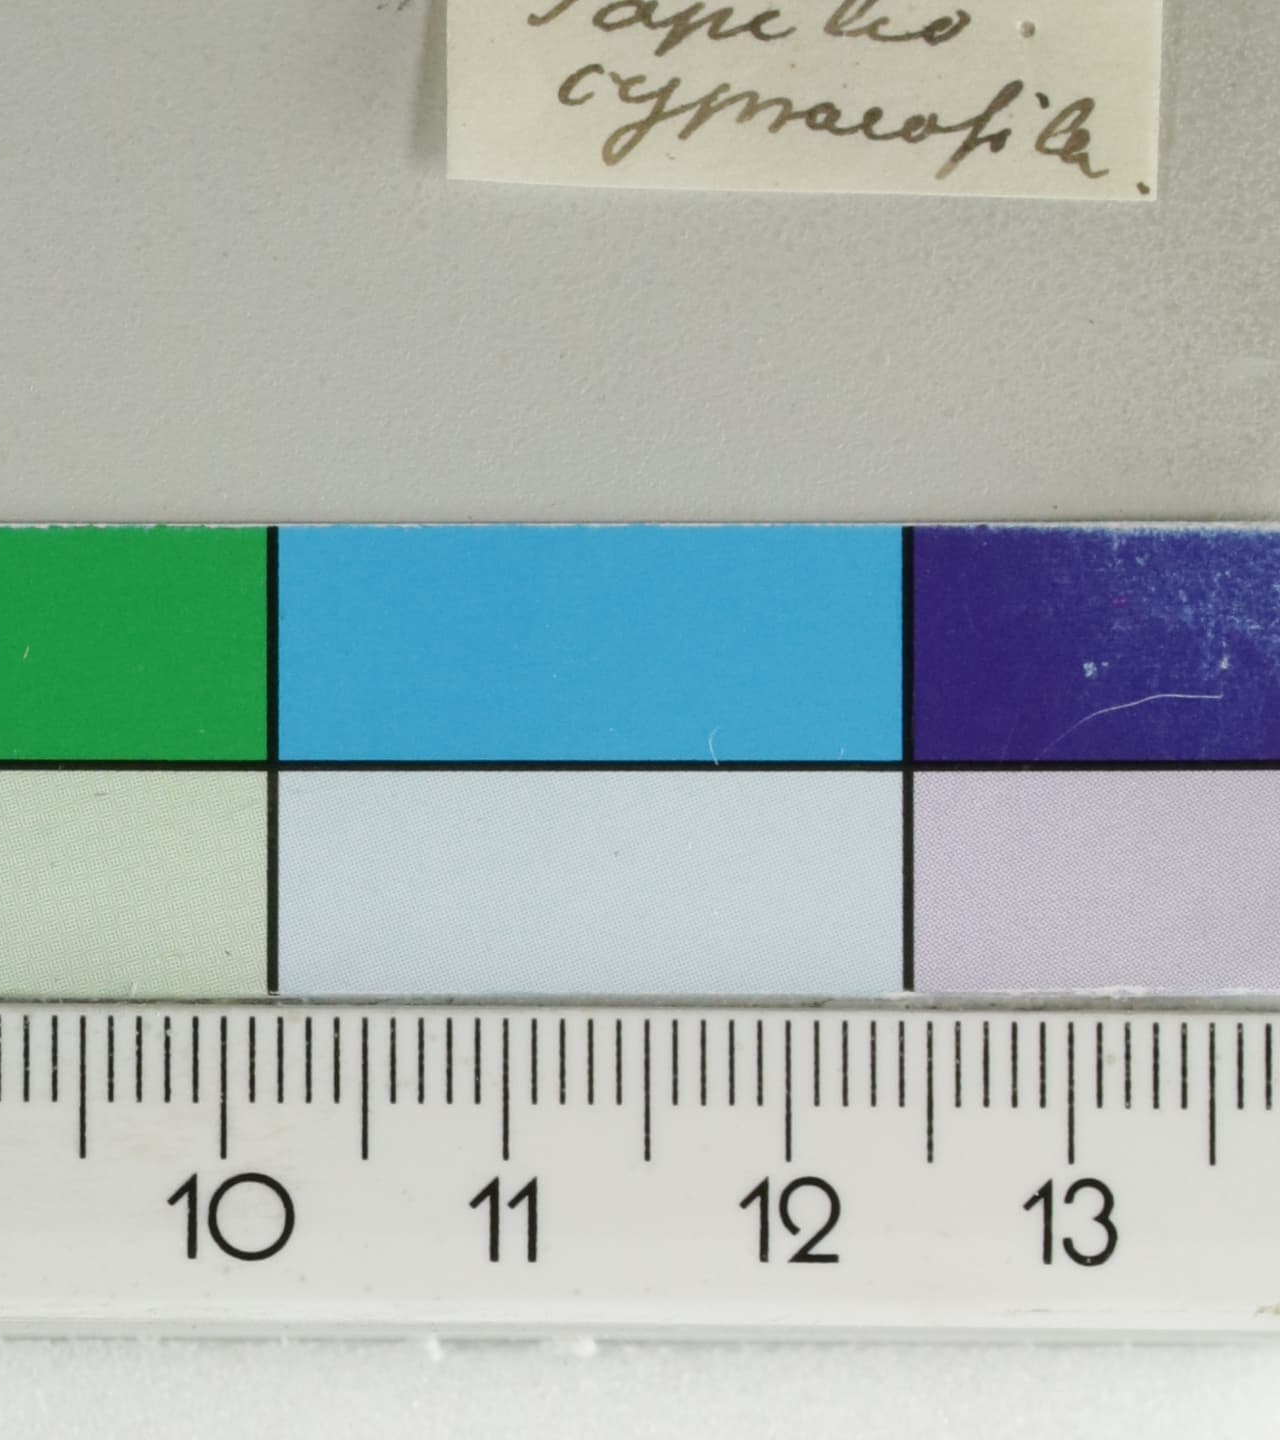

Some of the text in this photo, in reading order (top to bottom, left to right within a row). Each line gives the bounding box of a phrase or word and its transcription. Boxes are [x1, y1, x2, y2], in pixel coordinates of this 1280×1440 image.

[165, 1170, 297, 1263] 10
[467, 1175, 539, 1264] 11
[738, 1174, 842, 1265] 12
[1021, 1176, 1120, 1268] 13
